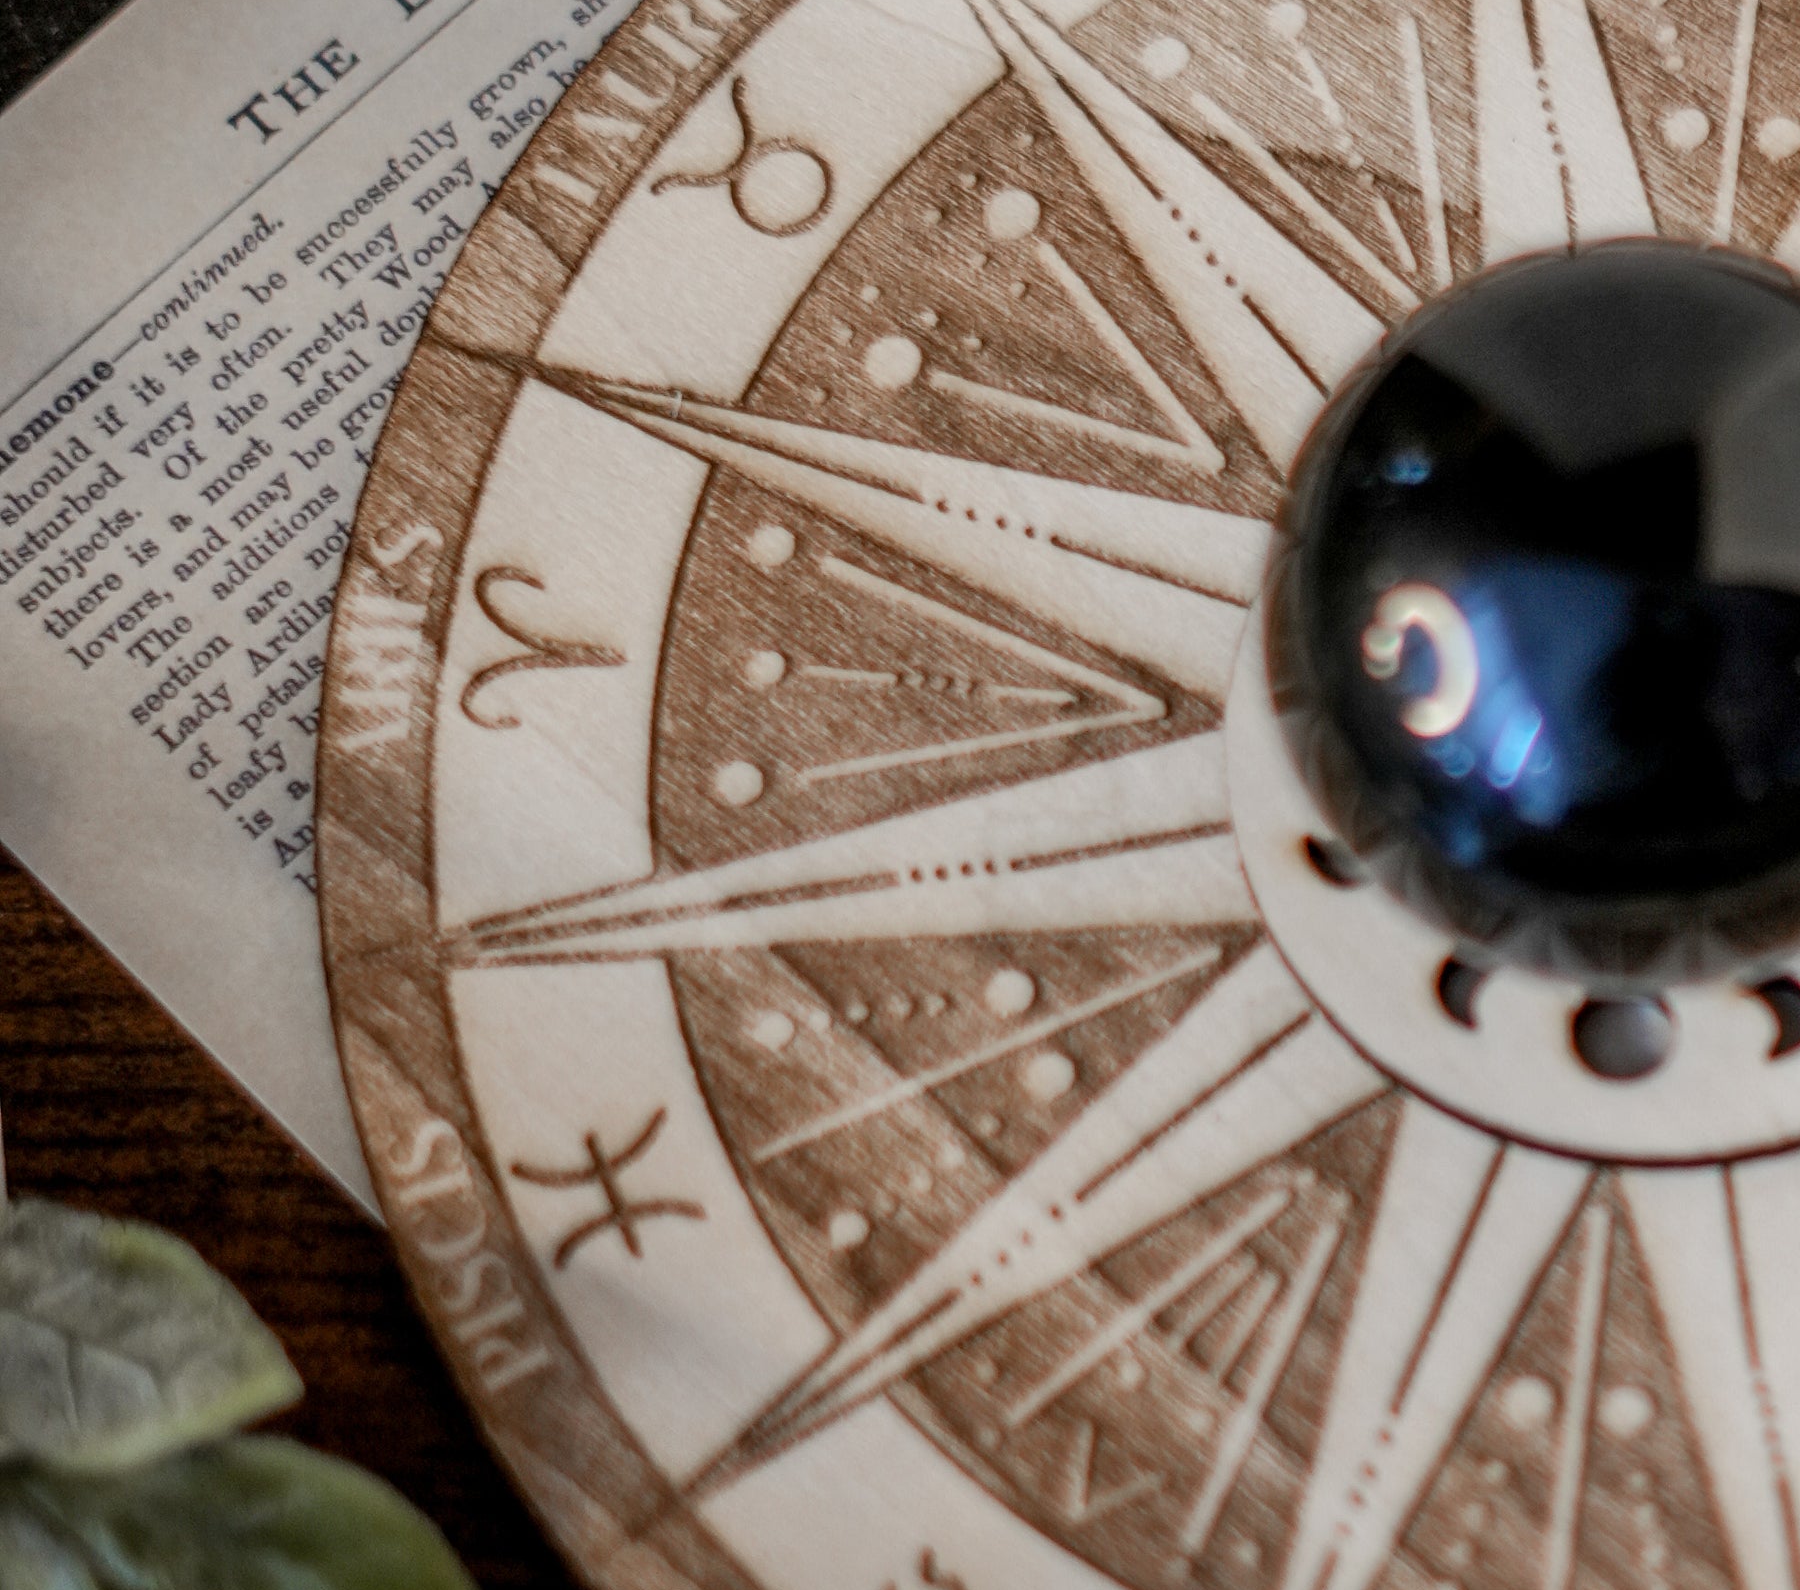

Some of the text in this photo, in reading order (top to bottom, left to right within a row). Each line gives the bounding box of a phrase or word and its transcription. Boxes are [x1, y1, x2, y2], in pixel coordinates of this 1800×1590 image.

[226, 37, 361, 146] THE
[0, 434, 96, 528] should
[95, 404, 128, 438] if
[131, 374, 166, 408] it
[164, 343, 202, 378] is
[205, 311, 242, 342] to
[240, 269, 289, 306] be
[296, 120, 460, 267] successfully
[468, 36, 568, 122] grown,
[129, 401, 197, 460] very
[210, 325, 294, 393] often.
[318, 222, 400, 291] They
[412, 156, 476, 215] may
[488, 97, 550, 150] also
[16, 213, 470, 616] subjects. Of the pretty Wood
[42, 348, 374, 642] there is a most useful
[65, 437, 337, 671] lovers, and may be
[126, 481, 342, 670] The additions
[129, 631, 235, 728] section
[244, 577, 295, 627] are
[336, 522, 446, 751] ARIES
[150, 584, 339, 755] Lady Ardila
[186, 652, 326, 781] of petals
[206, 741, 290, 812] leafy
